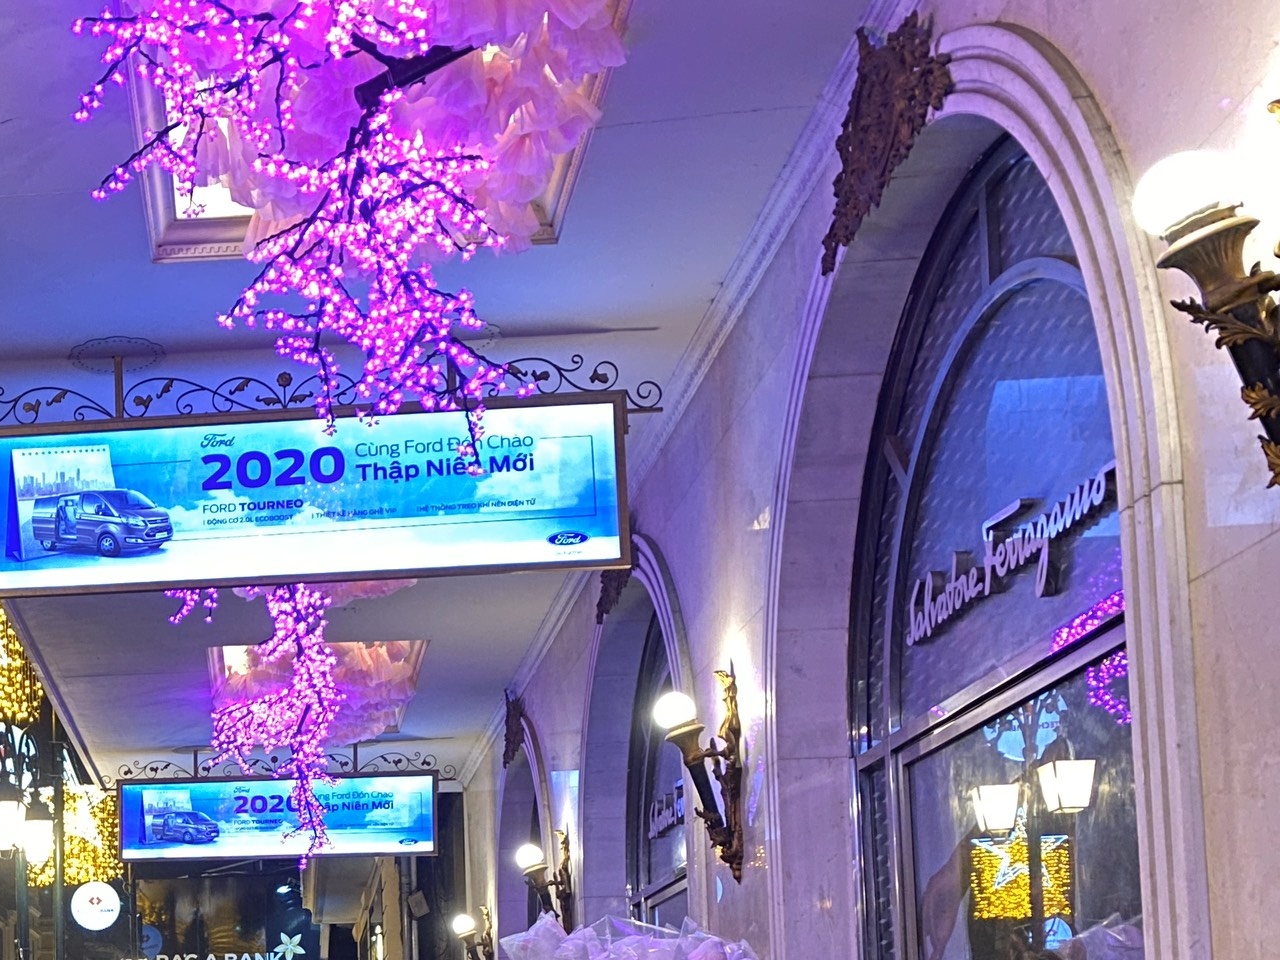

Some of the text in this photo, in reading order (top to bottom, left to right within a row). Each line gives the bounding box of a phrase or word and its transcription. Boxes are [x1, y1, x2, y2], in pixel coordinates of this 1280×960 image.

[200, 433, 235, 448] Ford
[355, 442, 400, 458] Cùng
[404, 438, 443, 454] Ford
[487, 434, 534, 449] Chào
[201, 446, 345, 491] 2020
[355, 452, 535, 483] Thập Niê Mới
[202, 498, 304, 514] FORD TOURNEO
[555, 533, 582, 545] Ford
[906, 459, 1117, 647] Salvatore Ferragamo
[331, 790, 351, 800] Ford
